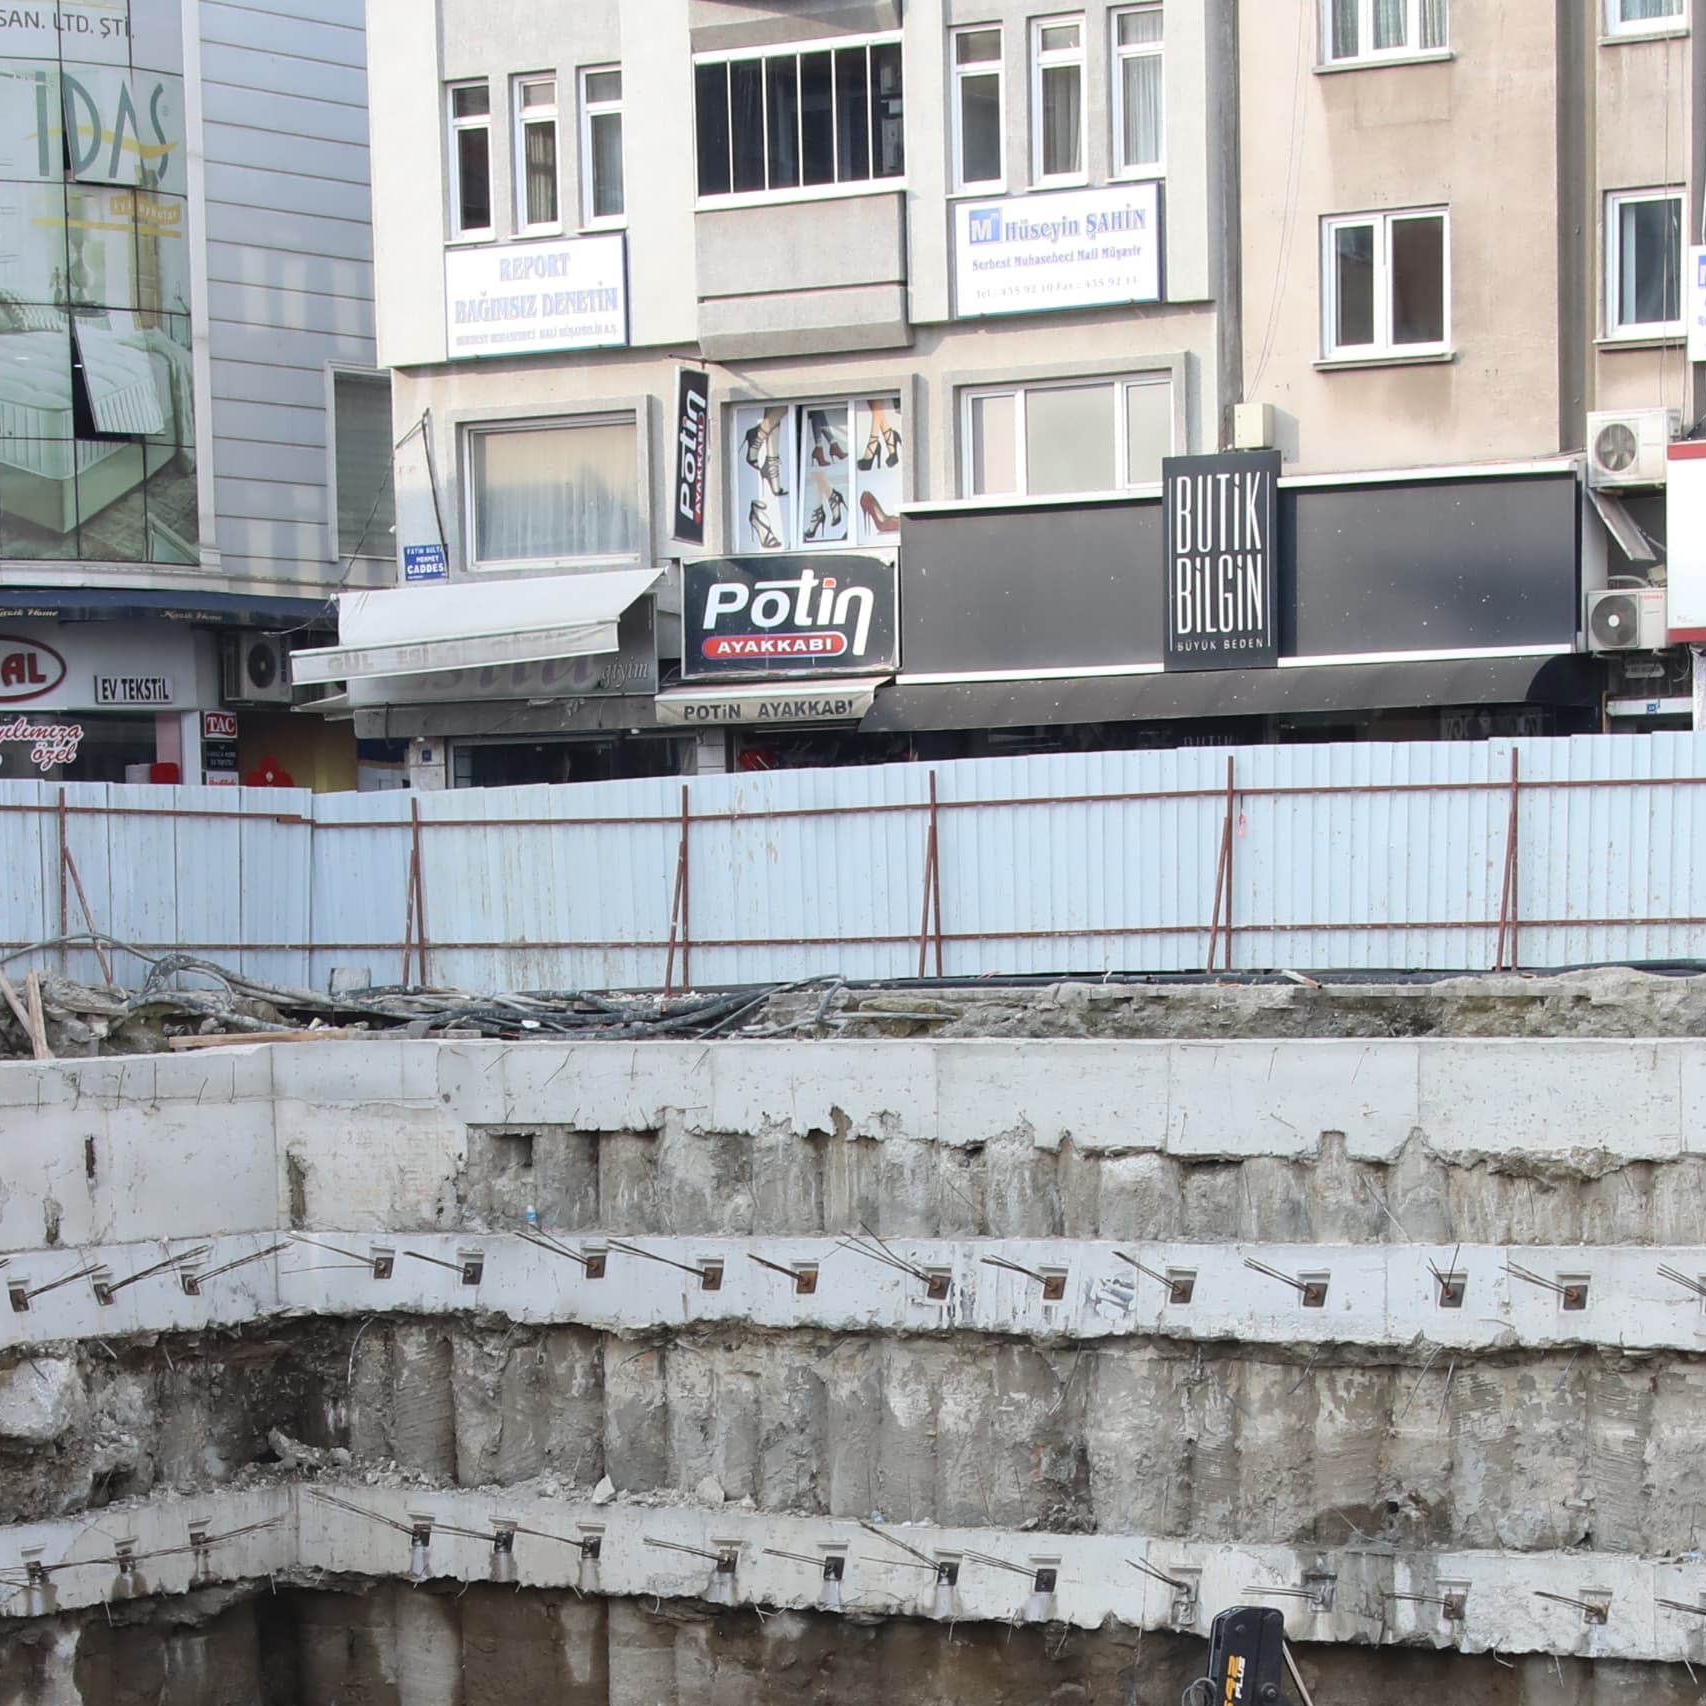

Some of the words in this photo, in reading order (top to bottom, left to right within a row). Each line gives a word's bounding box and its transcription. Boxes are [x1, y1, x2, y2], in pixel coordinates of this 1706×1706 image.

[53, 12, 94, 34] LTD.
[1006, 215, 1080, 243] Hüseyin
[1086, 203, 1147, 240] ŞAHİN
[499, 253, 571, 282] REPORT
[680, 389, 706, 520] Potin
[703, 569, 875, 656] Potin
[716, 637, 833, 655] AYAKKABI
[1223, 637, 1264, 650] BEDEN
[598, 655, 649, 685] giyim
[102, 678, 117, 700] EV
[756, 699, 853, 719] AYAKKABI
[30, 742, 78, 772] özel
[1235, 1656, 1247, 1700] PLUS
